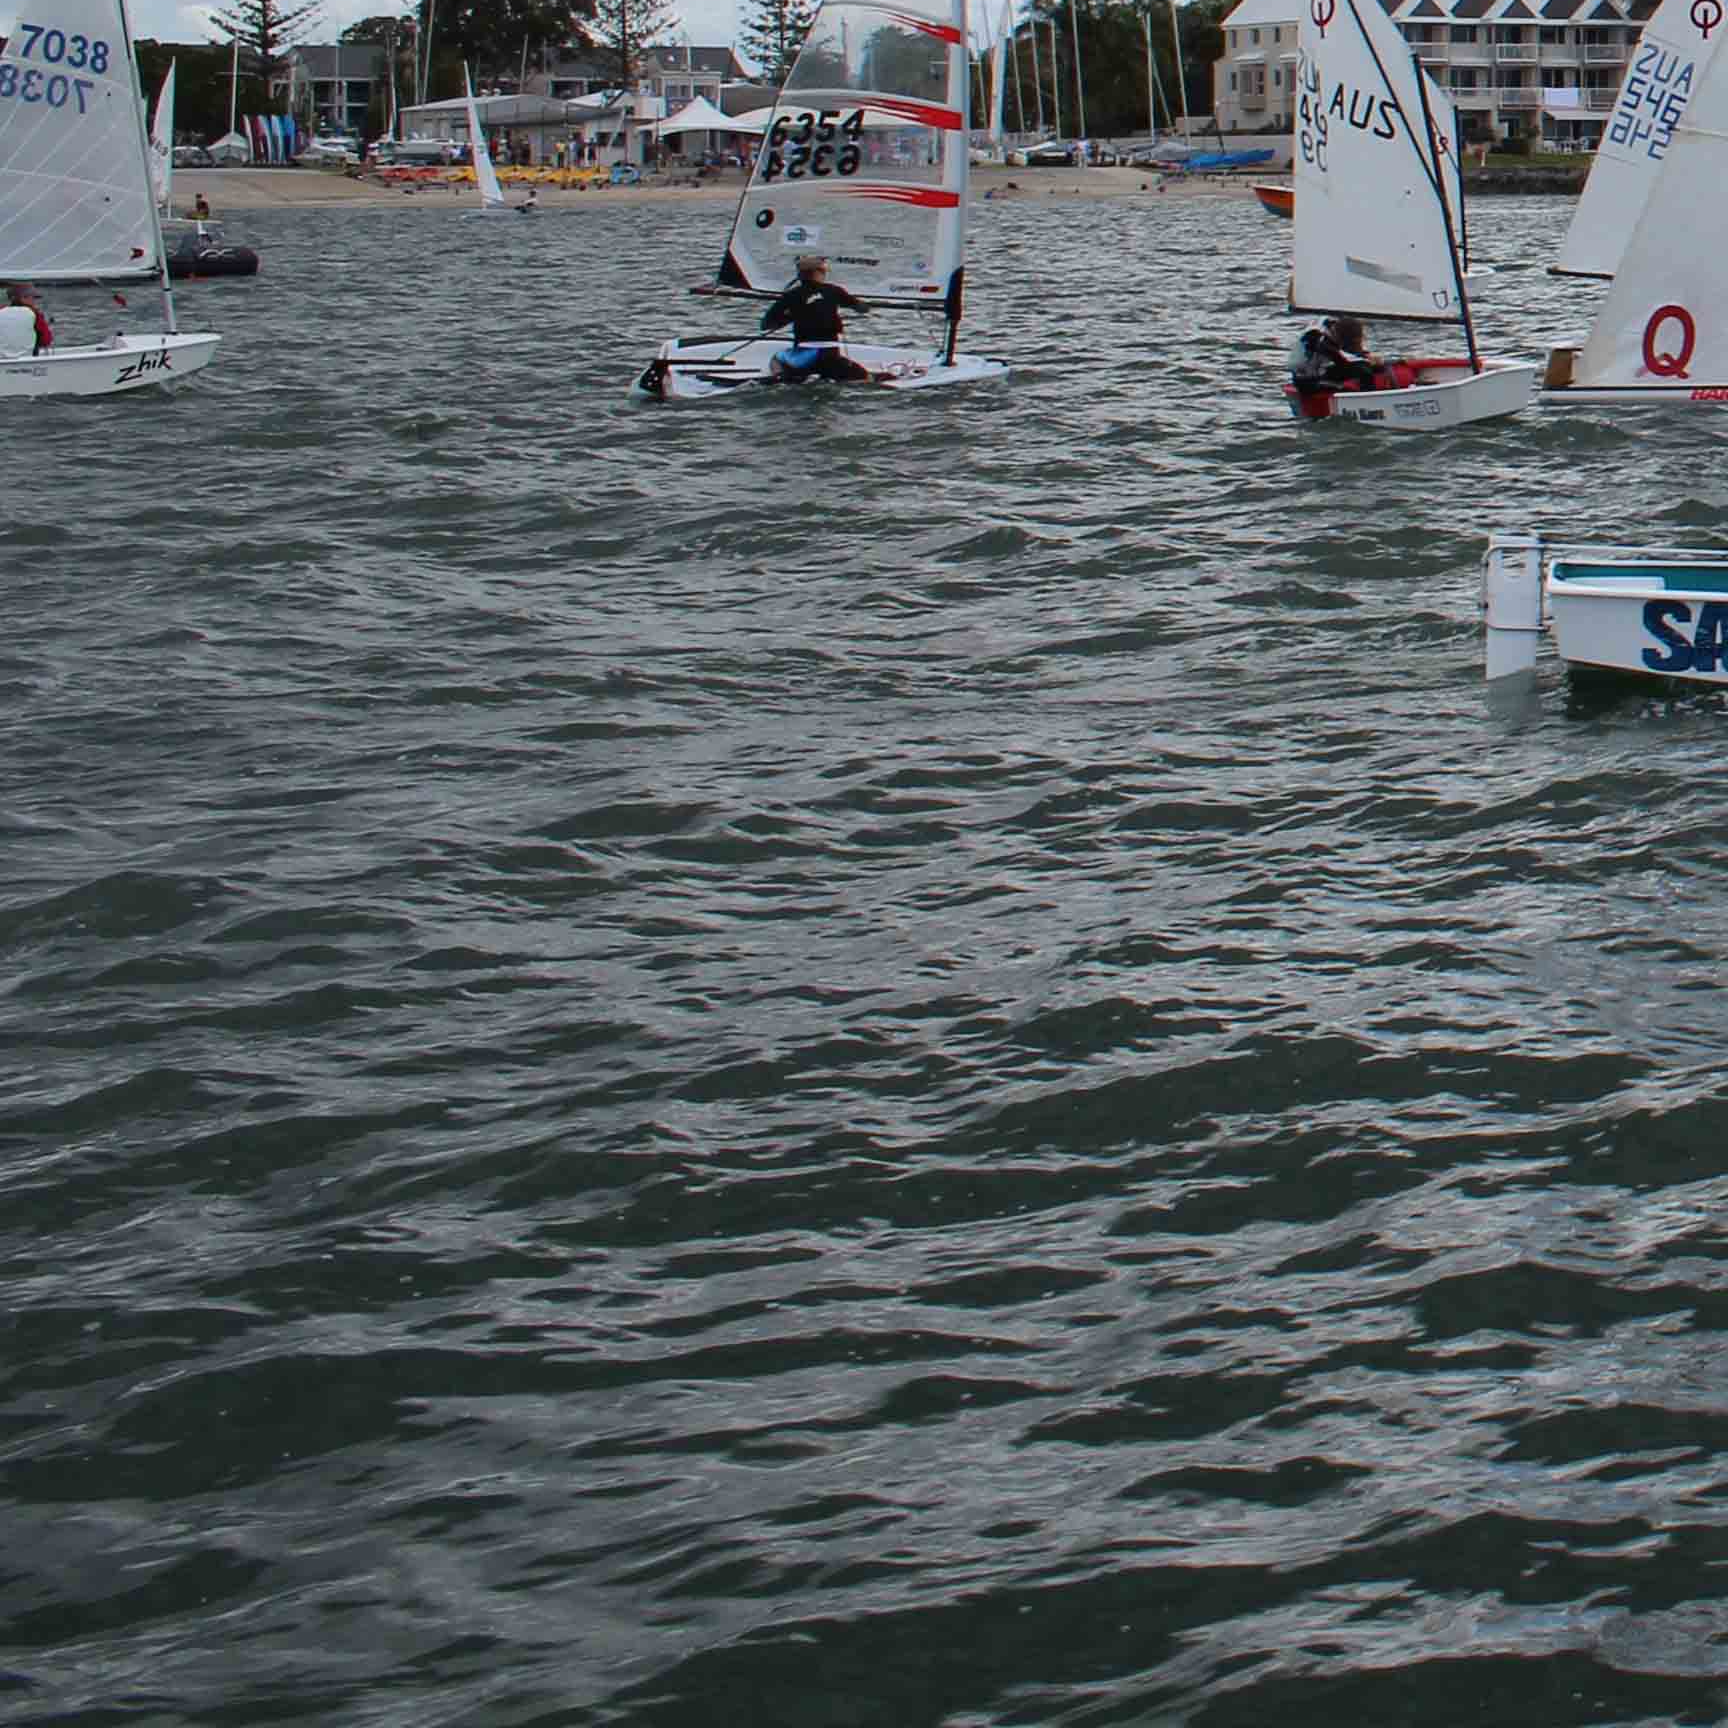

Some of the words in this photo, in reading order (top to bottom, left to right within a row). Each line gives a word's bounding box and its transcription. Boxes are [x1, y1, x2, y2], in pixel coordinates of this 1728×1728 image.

[21, 24, 110, 74] 7038
[1329, 83, 1397, 140] AUS
[1621, 77, 1687, 125] 546
[771, 109, 864, 146] 6354
[1642, 305, 1696, 379] Q
